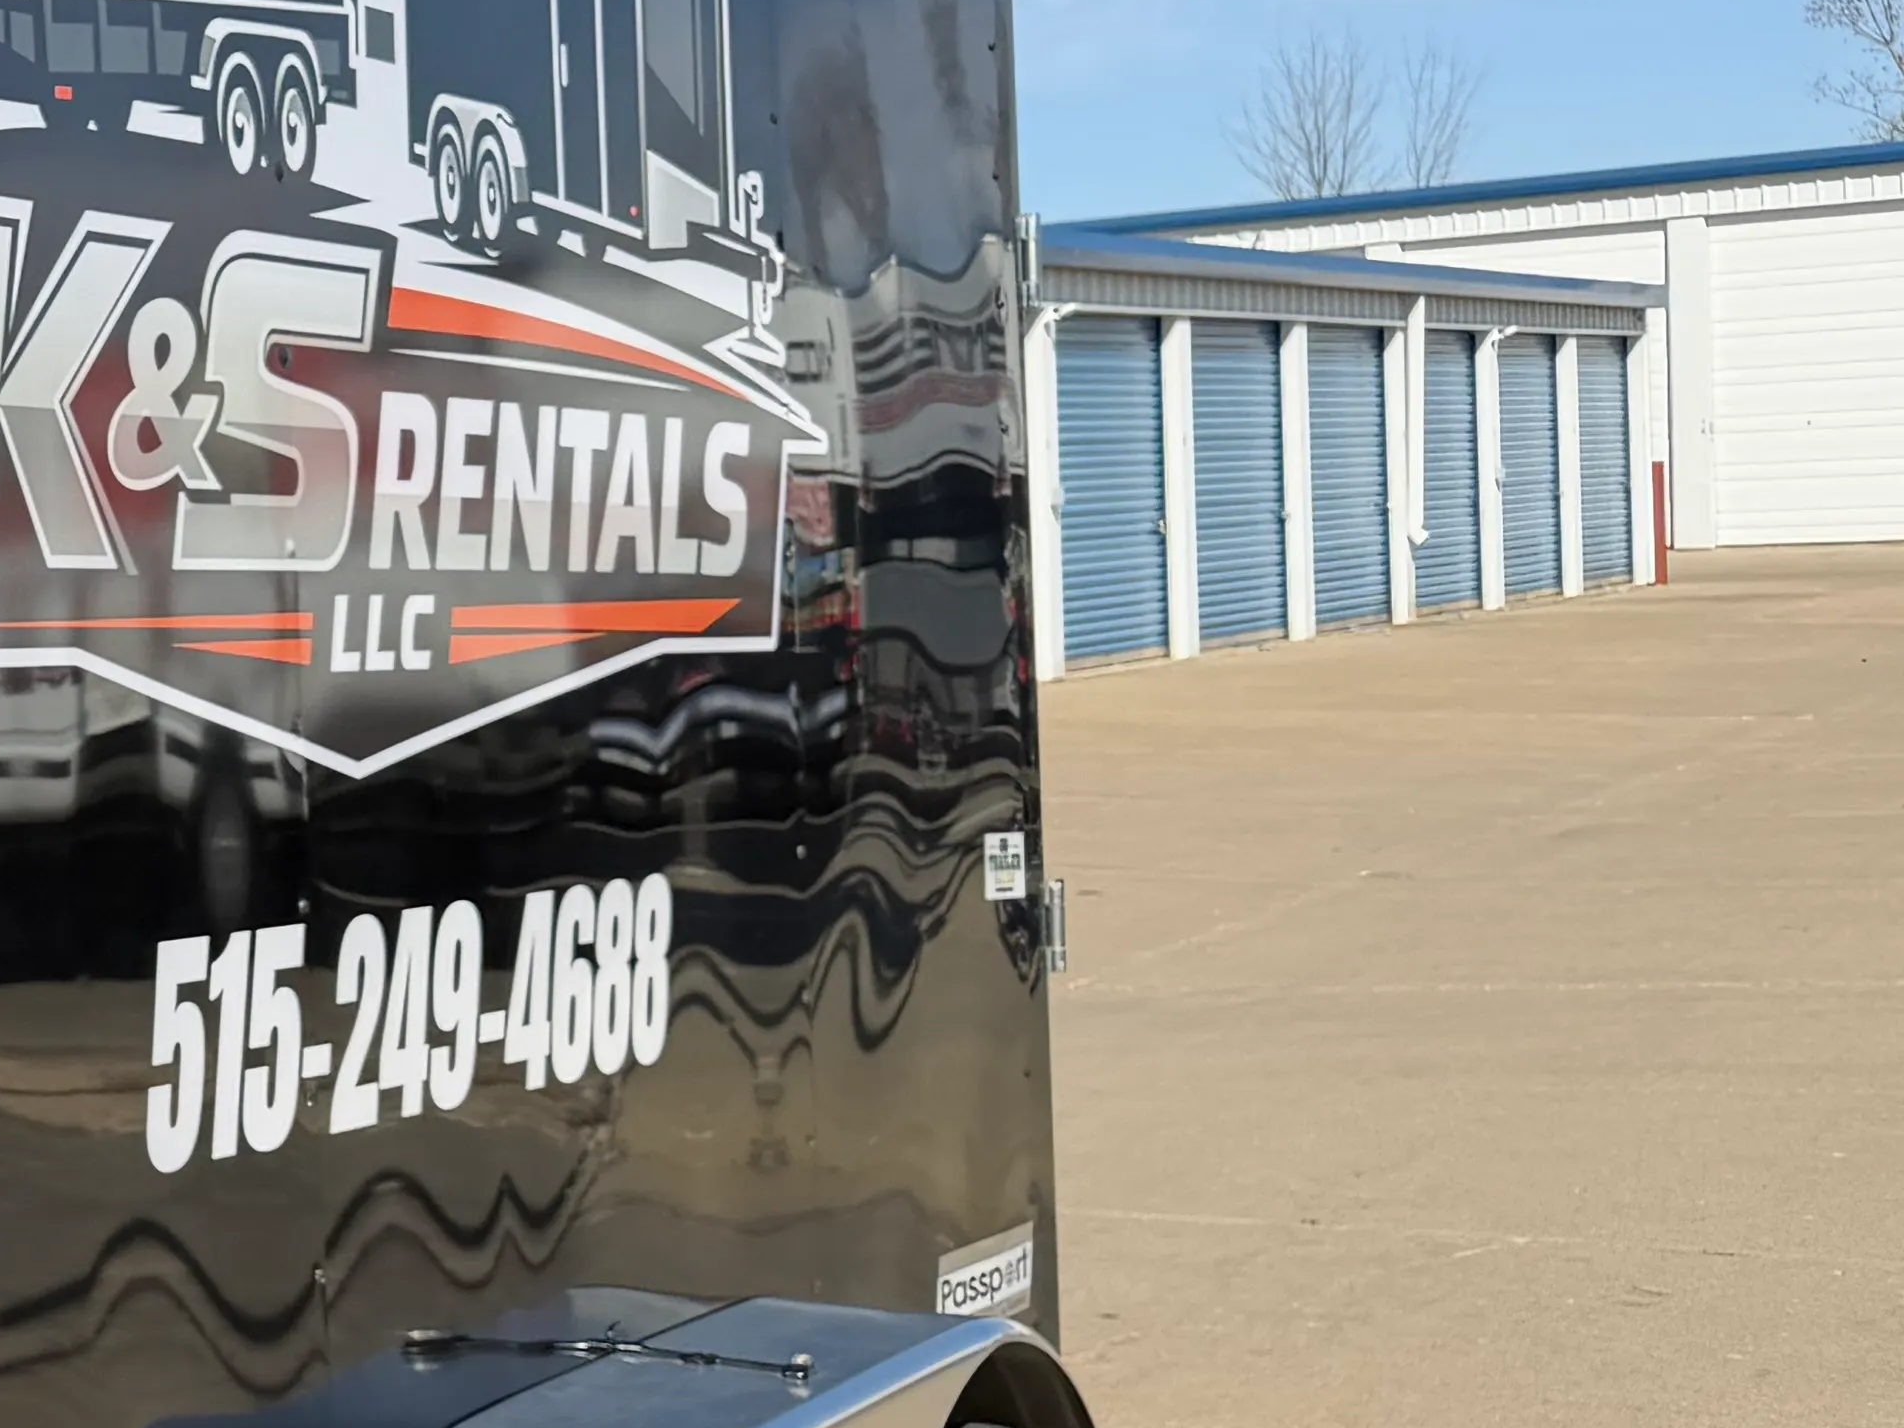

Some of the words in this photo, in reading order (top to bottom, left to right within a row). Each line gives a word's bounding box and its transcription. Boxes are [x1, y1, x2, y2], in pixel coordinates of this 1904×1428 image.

[369, 391, 751, 576] RENTALS
[330, 593, 435, 673] LLC
[145, 871, 673, 1173] 515-249-4688
